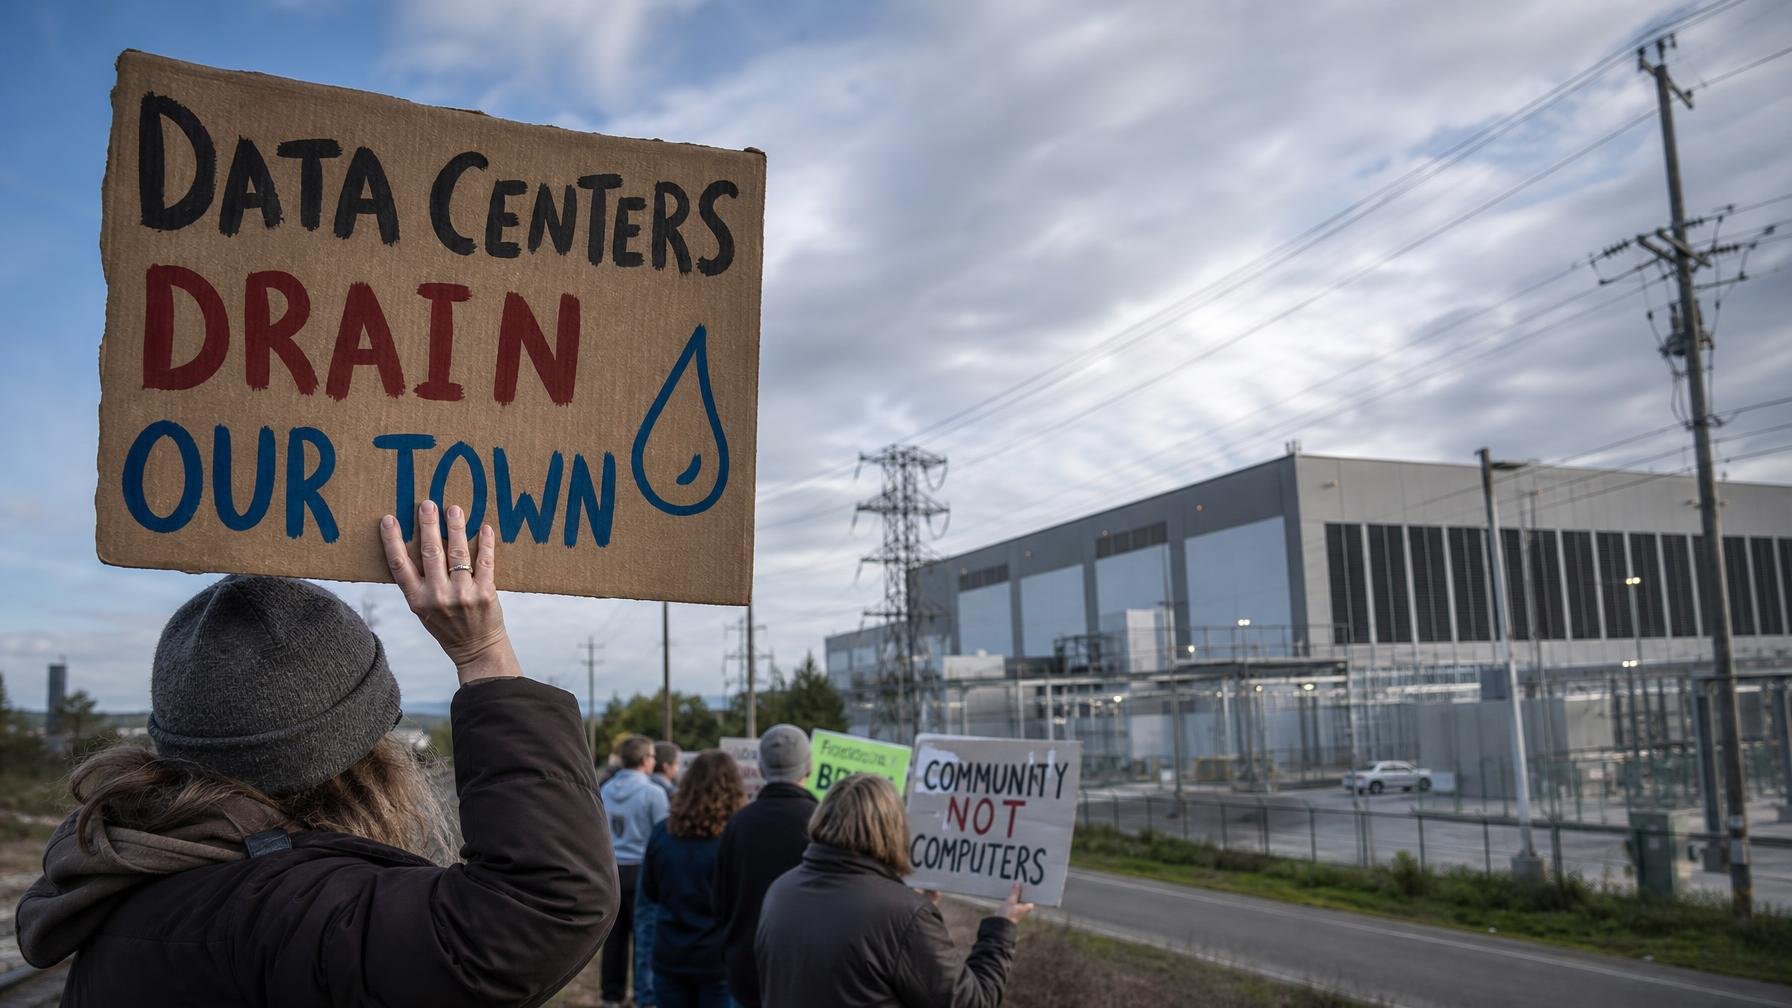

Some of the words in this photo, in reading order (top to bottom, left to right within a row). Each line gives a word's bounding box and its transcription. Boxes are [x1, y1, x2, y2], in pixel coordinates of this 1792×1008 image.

[138, 91, 400, 246] DATA
[429, 151, 739, 277] CENTERS
[141, 263, 582, 407] DRAIN
[122, 419, 340, 544] OUR
[372, 433, 616, 549] TOWN
[924, 760, 1068, 799] COMMUNITY
[947, 796, 1026, 838] NOT
[910, 833, 1047, 885] COMPUTERS
